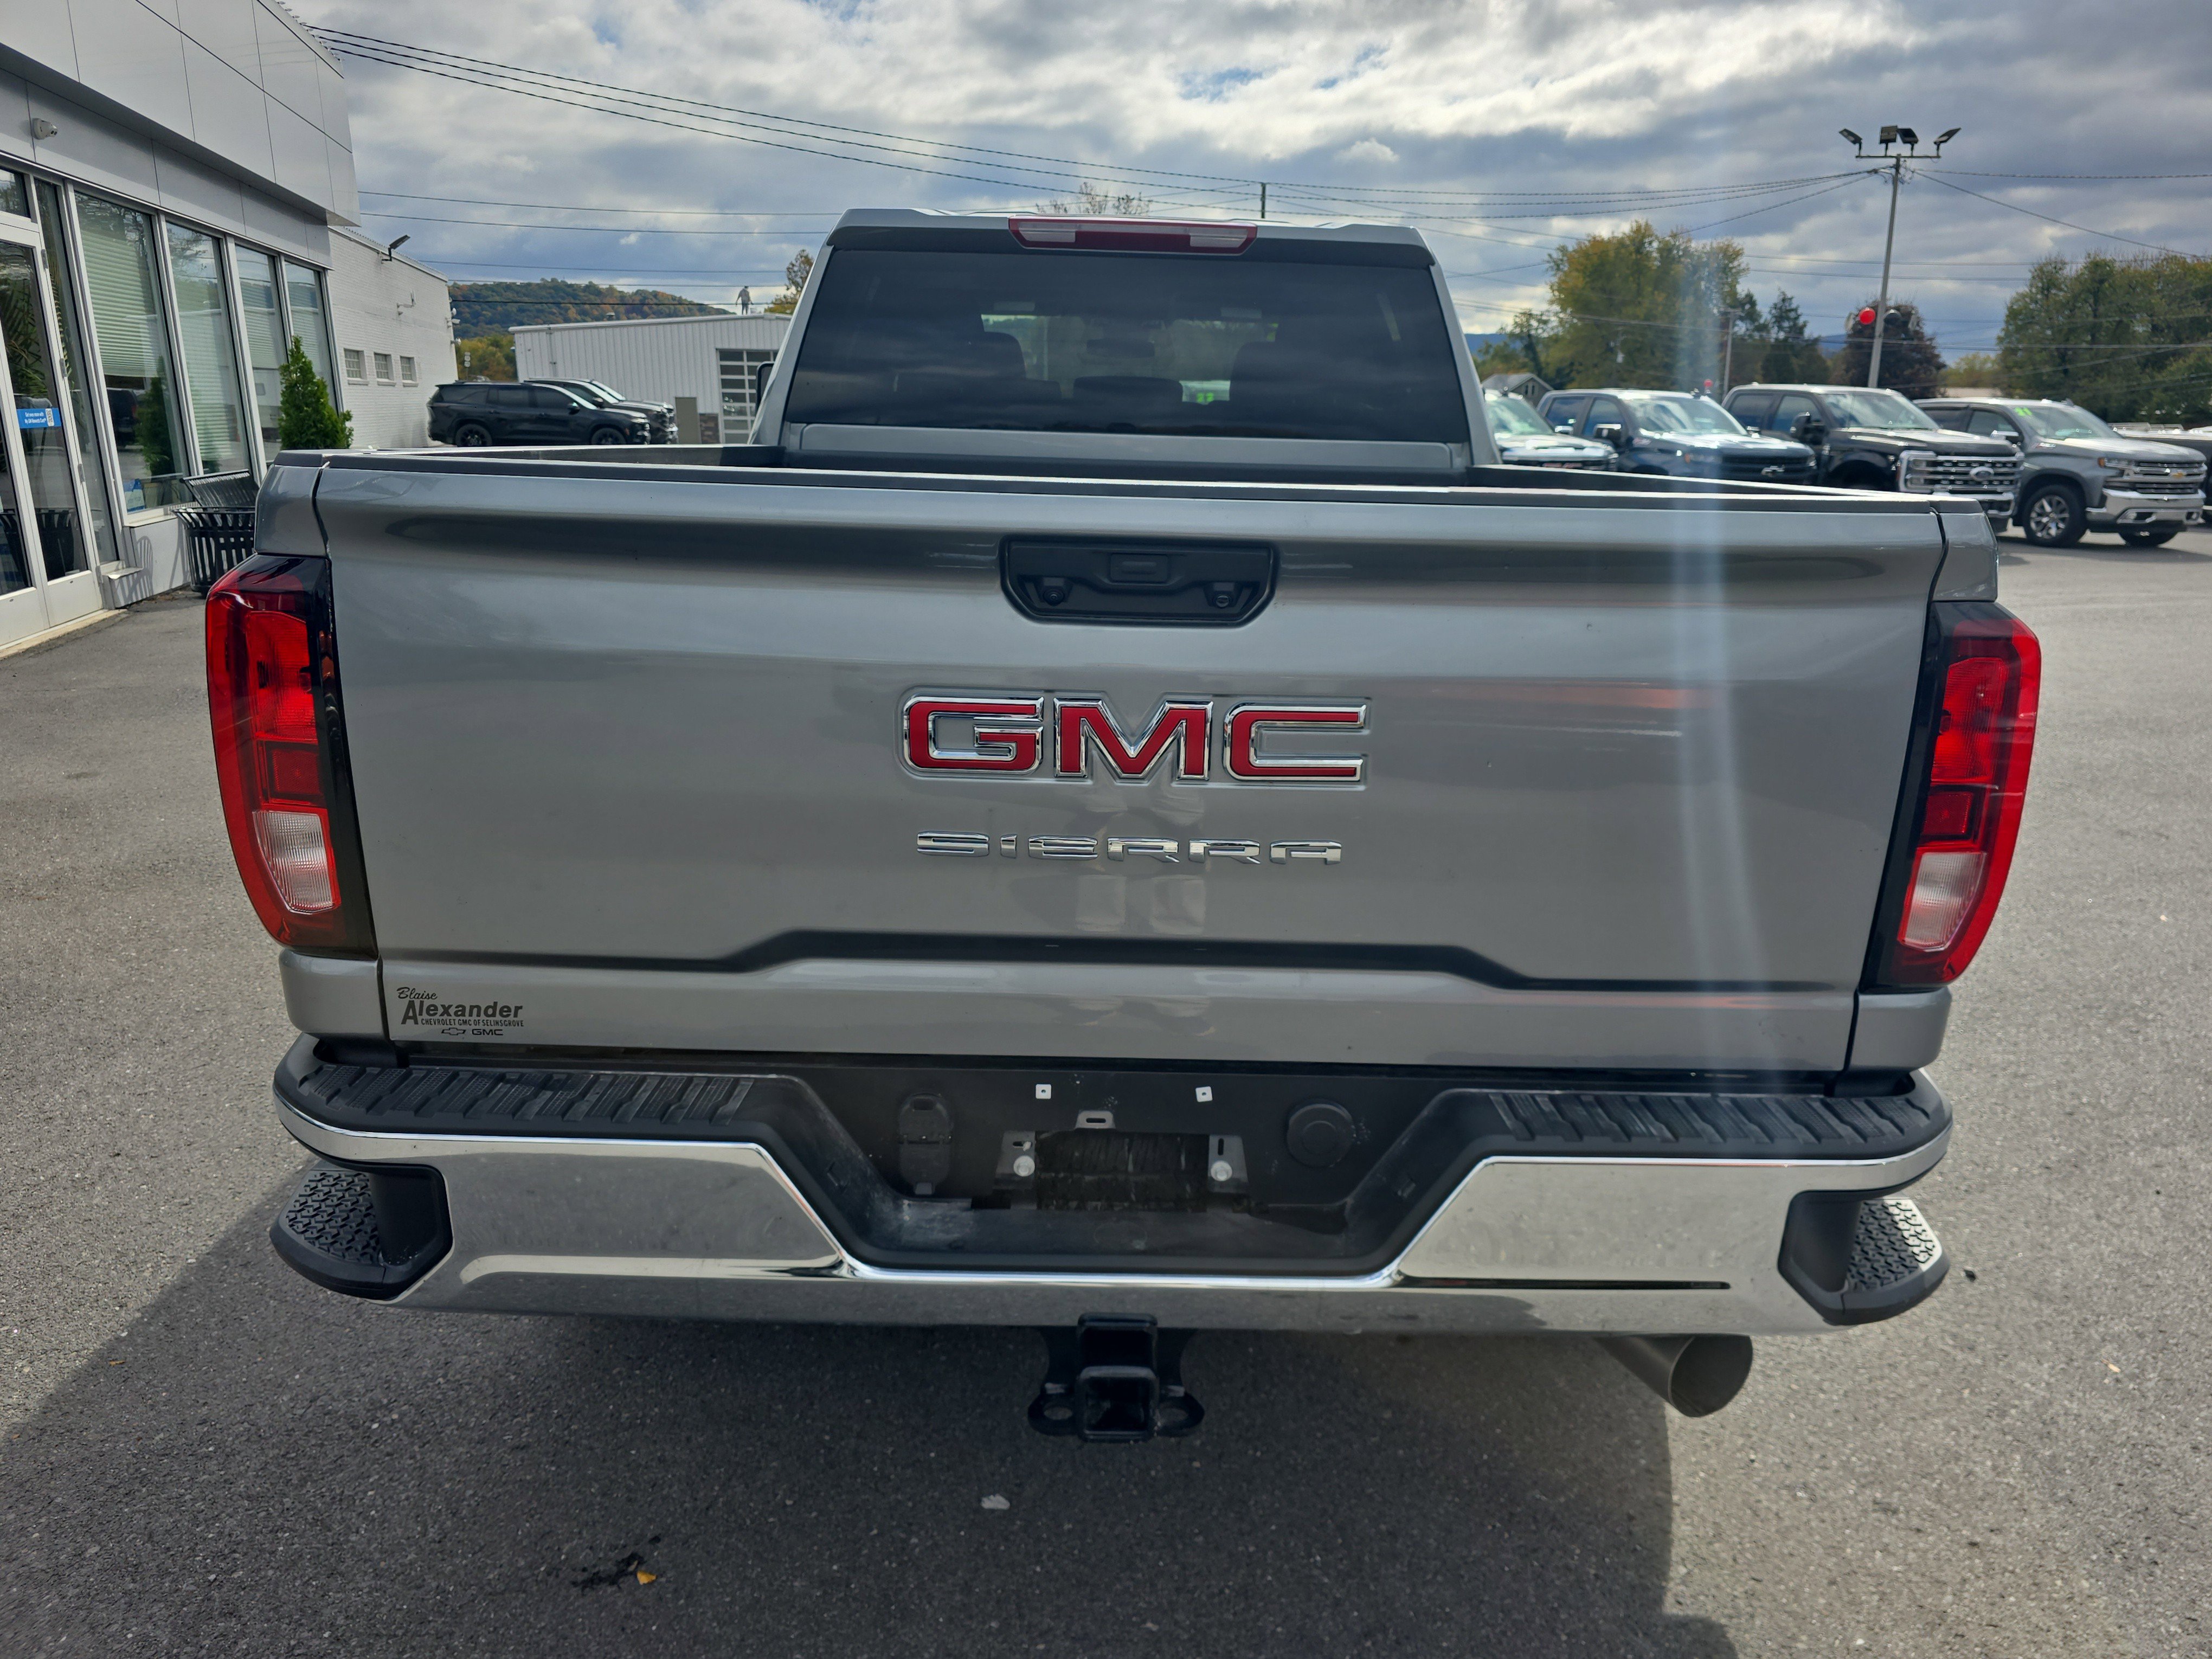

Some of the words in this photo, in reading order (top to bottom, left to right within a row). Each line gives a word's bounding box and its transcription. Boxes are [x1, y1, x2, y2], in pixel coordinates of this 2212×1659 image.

[903, 695, 1368, 782] GMC
[916, 831, 1342, 865] SIERRA
[396, 986, 438, 1000] Blaise
[401, 1000, 523, 1025] Alexander
[421, 1018, 456, 1026] CHEVROLET
